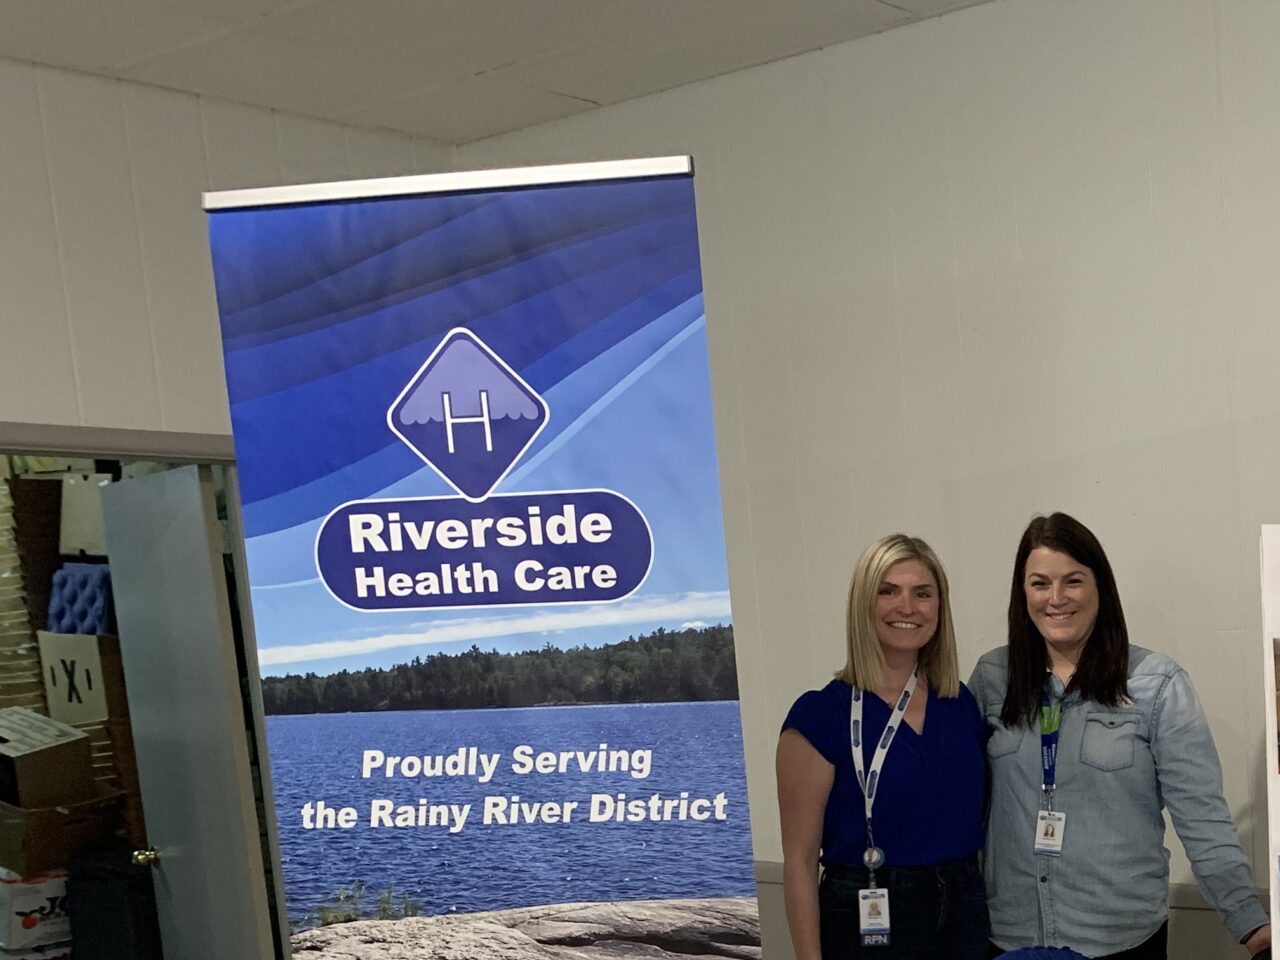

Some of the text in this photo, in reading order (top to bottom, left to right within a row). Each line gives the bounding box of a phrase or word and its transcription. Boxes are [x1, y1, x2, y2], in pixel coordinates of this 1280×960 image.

[441, 390, 494, 454] H
[348, 504, 613, 553] Riverside
[354, 560, 618, 598] Health Care
[362, 744, 653, 783] Proudly Serving
[302, 792, 728, 833] the Rainy River District
[864, 935, 888, 945] RPN
